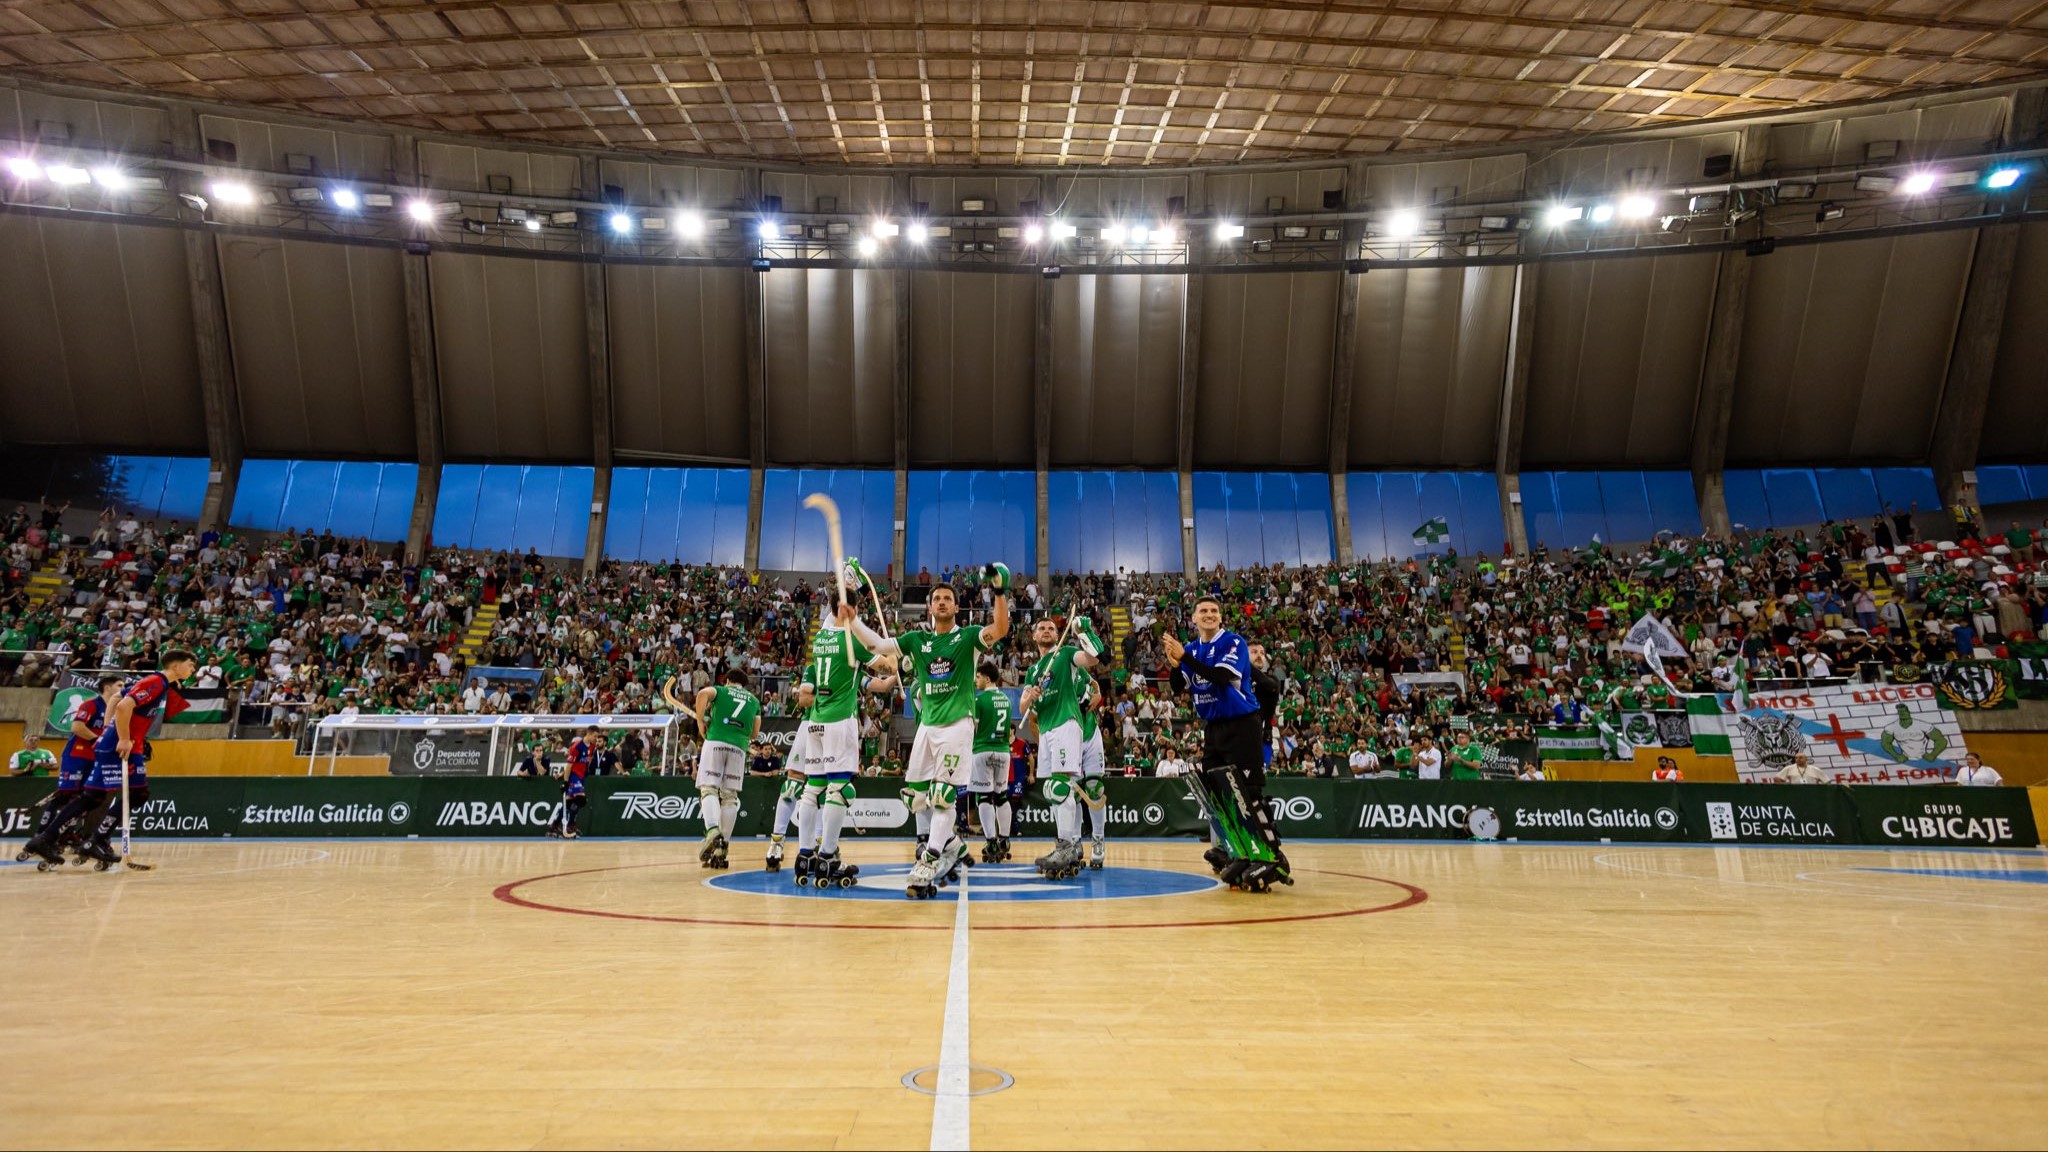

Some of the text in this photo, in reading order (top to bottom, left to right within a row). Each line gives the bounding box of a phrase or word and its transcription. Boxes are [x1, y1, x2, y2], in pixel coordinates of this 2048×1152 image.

[816, 657, 832, 686] 11
[1852, 685, 1936, 703] LICEO
[732, 697, 747, 718] 7
[996, 709, 1007, 731] 2
[436, 756, 479, 766] DA CORUÑA
[437, 749, 481, 759] Deputación
[944, 754, 960, 768] 57
[1060, 749, 1066, 759] 5
[1876, 771, 1891, 782] A
[241, 803, 384, 824] Estrella Galicia
[865, 809, 891, 817] Coruña
[1015, 804, 1055, 823] strel
[1370, 804, 1467, 828] ABANC
[1738, 805, 1796, 820] XUNTA
[1924, 804, 1962, 815] GRUPO
[142, 816, 209, 831] GALICIA
[1515, 807, 1651, 828] Estrella Galicia
[1741, 822, 1835, 837] DE GALICIA
[1882, 816, 2013, 843] C4BICAJE
